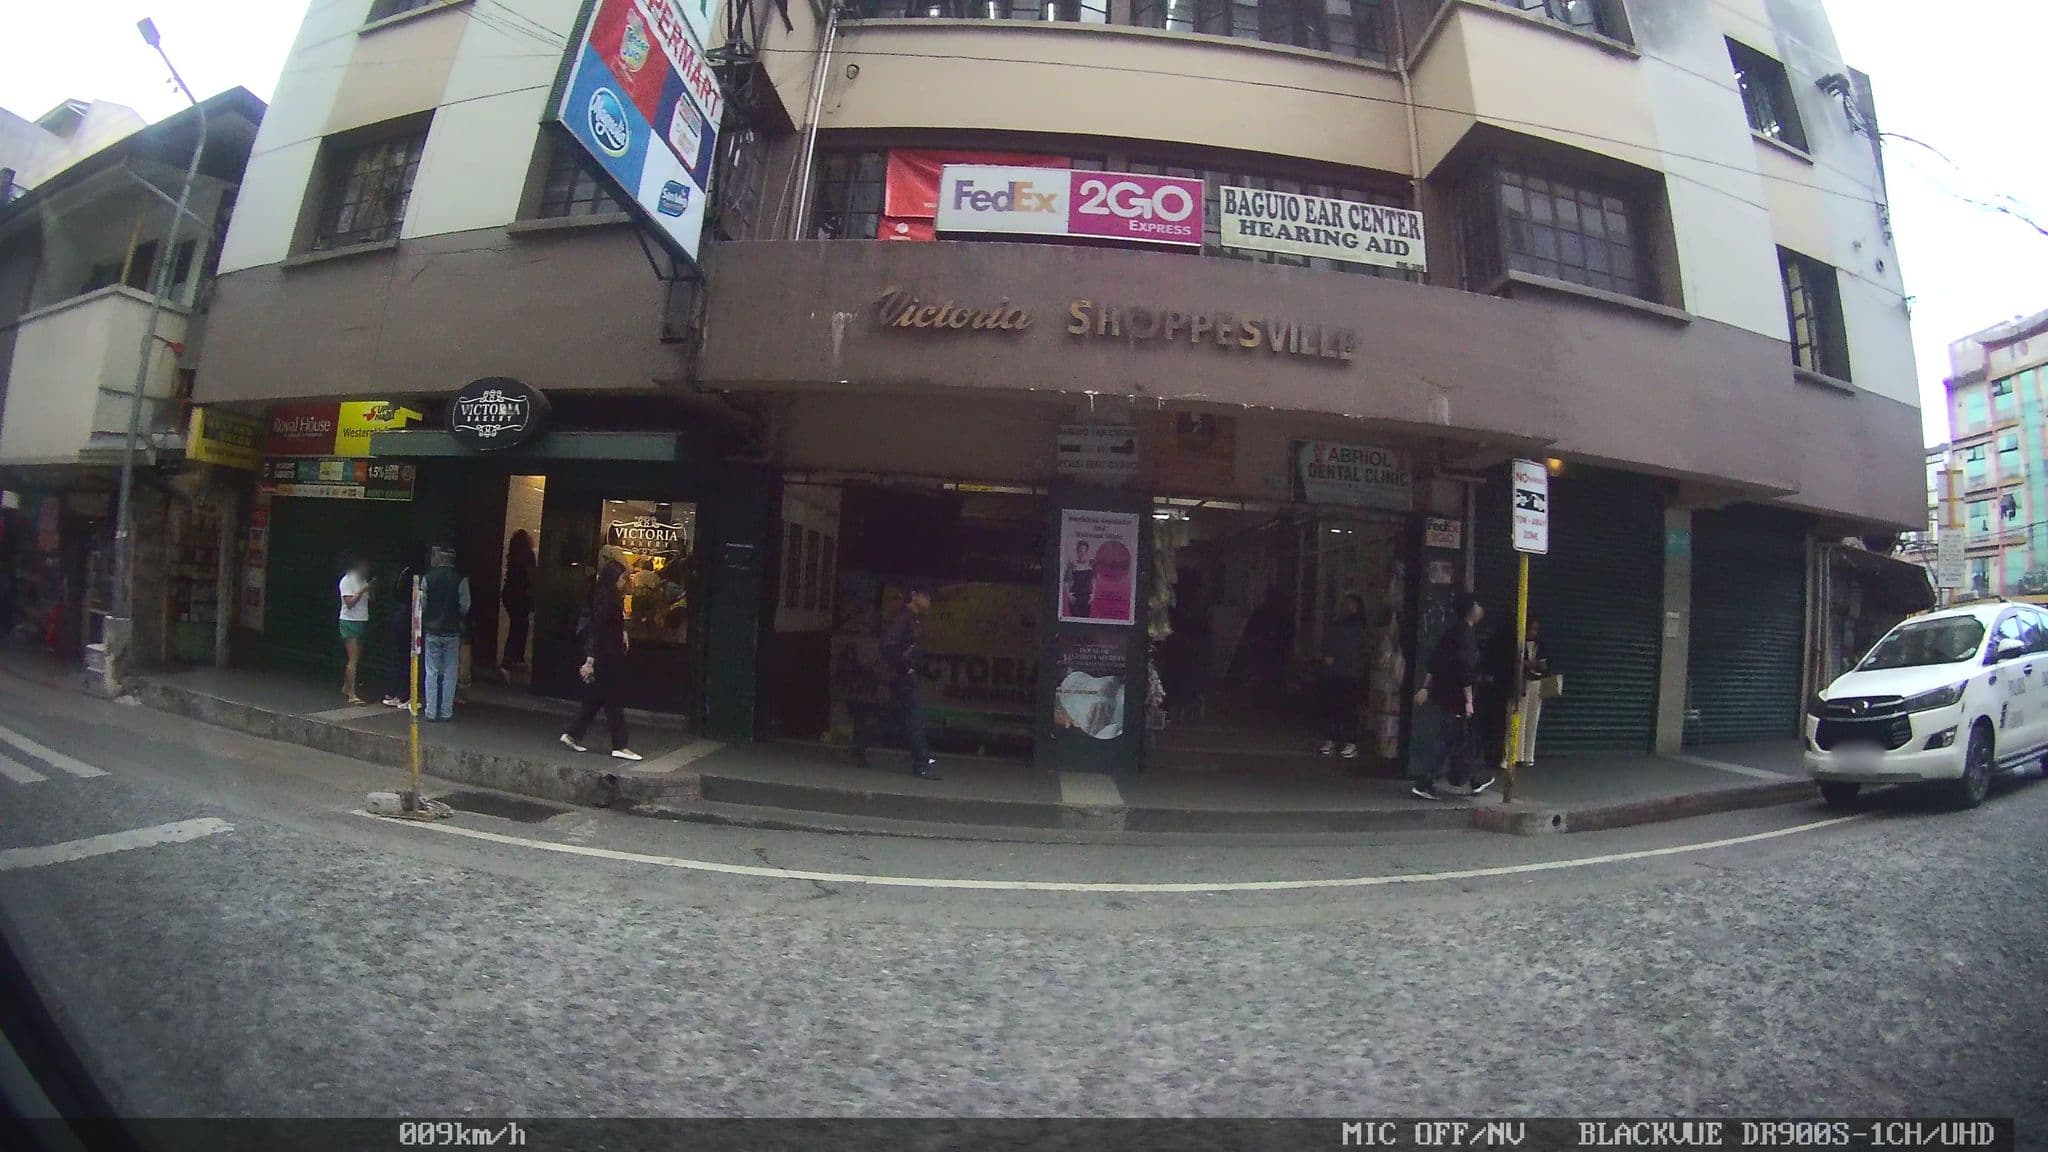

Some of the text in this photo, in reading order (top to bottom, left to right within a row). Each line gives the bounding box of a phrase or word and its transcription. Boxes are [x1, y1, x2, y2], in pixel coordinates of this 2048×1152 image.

[953, 180, 1058, 213] FedEx
[1078, 179, 1194, 222] 2GO
[1224, 188, 1421, 241] BAGUIO EAR CENTER
[1238, 218, 1410, 257] HEARING AID
[878, 287, 1355, 361] Victoria SHOPPESVILLE
[461, 403, 520, 415] VICTORIA
[272, 416, 331, 433] Royal House
[1327, 447, 1392, 468] ABRIOL
[1307, 462, 1409, 488] DENTAL CLINIC
[1515, 472, 1527, 483] NO
[614, 527, 677, 541] VICTORIA
[621, 538, 669, 548] BAKERY
